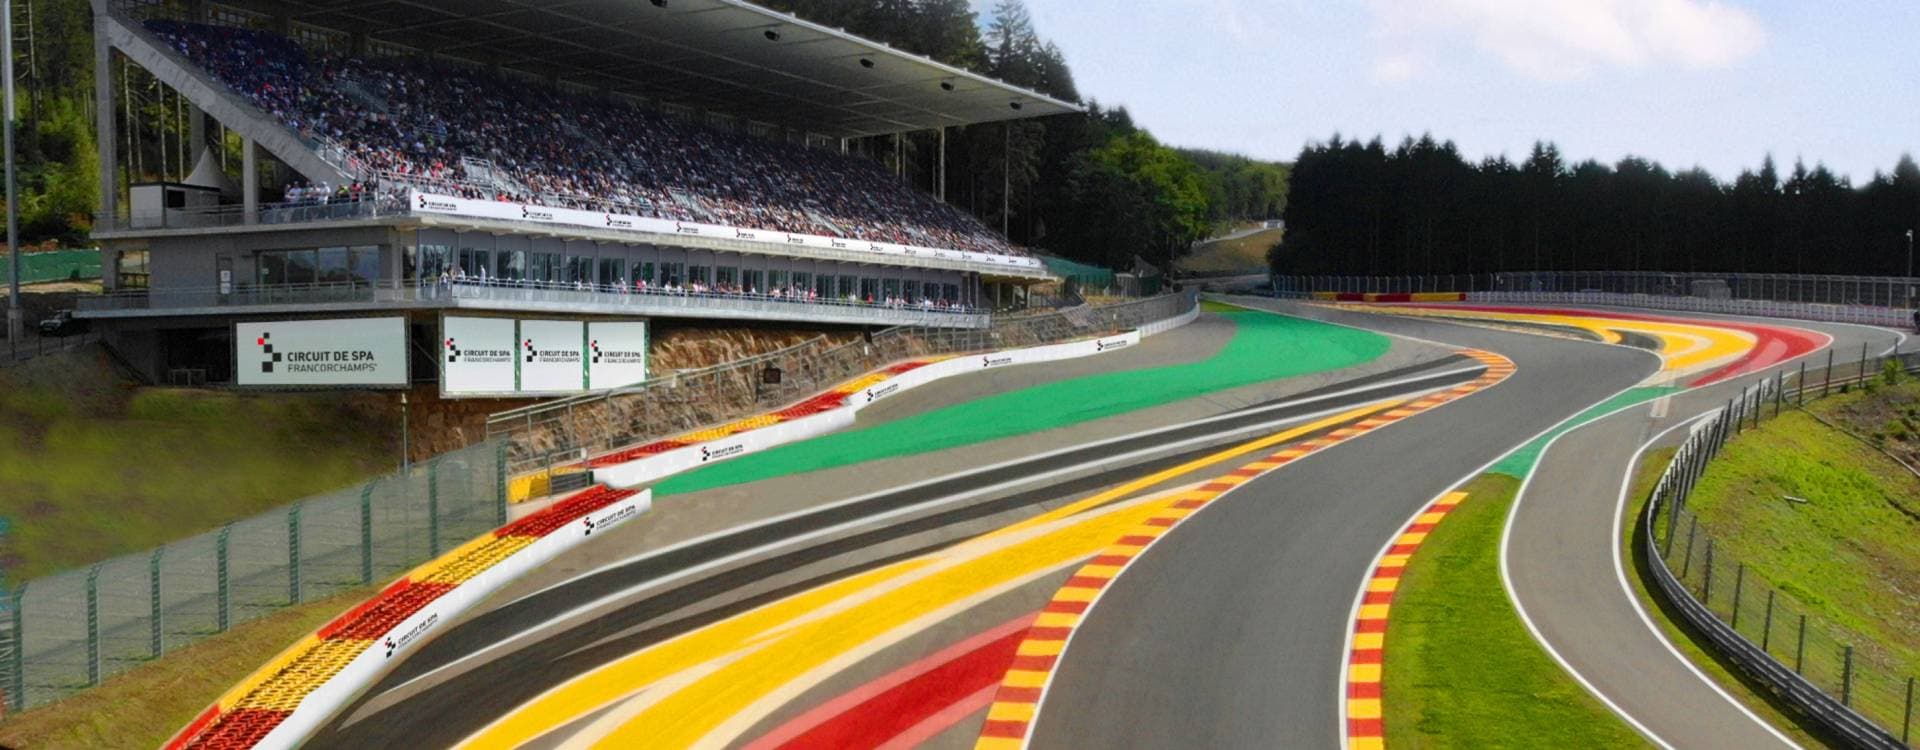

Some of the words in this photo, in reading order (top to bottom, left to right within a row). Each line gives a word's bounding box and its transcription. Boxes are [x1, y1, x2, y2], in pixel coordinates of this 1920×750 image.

[287, 352, 330, 362] CIRCUIT
[333, 351, 349, 361] DE
[352, 350, 374, 360] SPA
[288, 363, 376, 372] FRANCORCHAMPS
[596, 512, 616, 526] CIRCUIT
[398, 626, 418, 644] CIRCUIT
